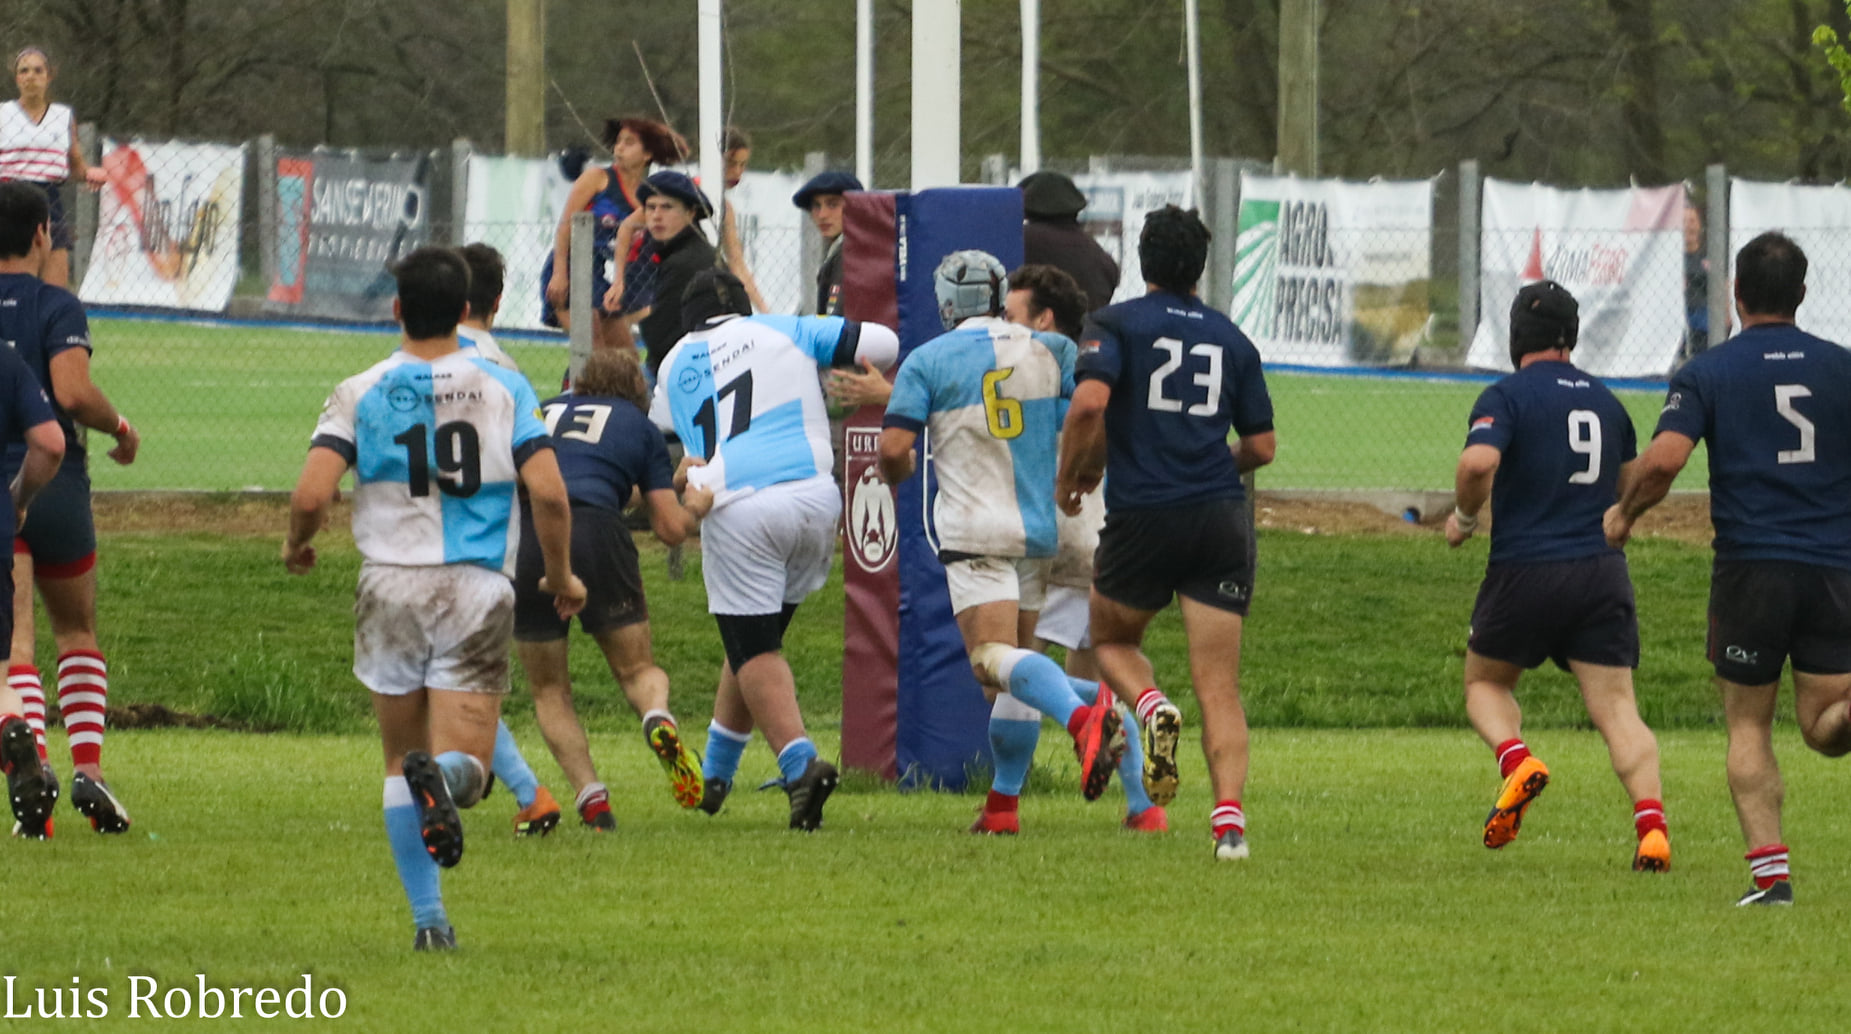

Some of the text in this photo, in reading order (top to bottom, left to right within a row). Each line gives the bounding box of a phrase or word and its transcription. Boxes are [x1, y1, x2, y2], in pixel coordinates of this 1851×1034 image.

[692, 368, 753, 463] 17
[981, 365, 1024, 440] 6
[1147, 336, 1223, 417] 23
[394, 420, 482, 499] 19
[542, 402, 613, 445] 13
[1567, 409, 1602, 484] 9
[1774, 384, 1815, 464] 5
